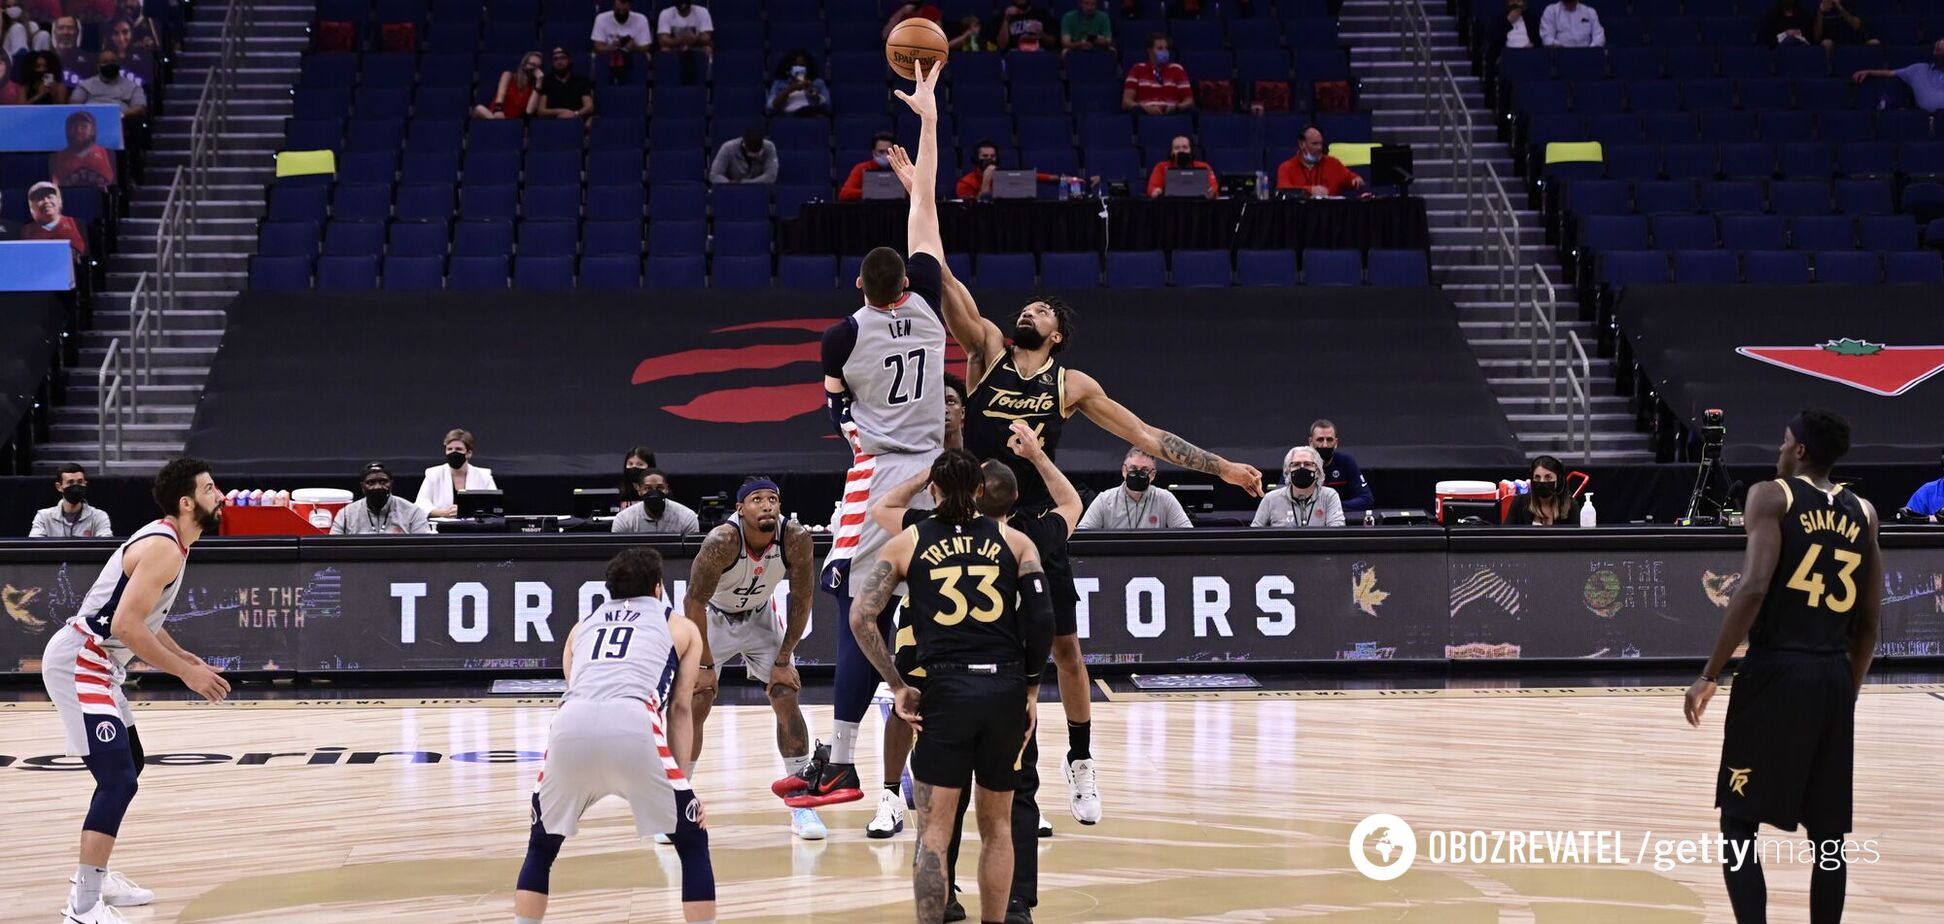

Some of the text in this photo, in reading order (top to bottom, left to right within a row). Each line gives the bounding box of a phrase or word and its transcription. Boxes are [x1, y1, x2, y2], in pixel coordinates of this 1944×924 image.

[888, 319, 911, 339] LEN
[884, 347, 926, 406] 27
[987, 386, 1054, 413] Toronto
[1800, 509, 1860, 544] SIAKAM
[919, 536, 1001, 566] TRENT JR.
[1786, 543, 1862, 613] 43
[239, 587, 304, 606] WE THE
[735, 597, 748, 608] 3
[929, 565, 1004, 626] 33
[1015, 575, 1297, 638] TORS
[239, 608, 305, 628] NORTH
[605, 609, 641, 622] NETO
[590, 626, 635, 661] 19
[0, 746, 547, 771] gerine
